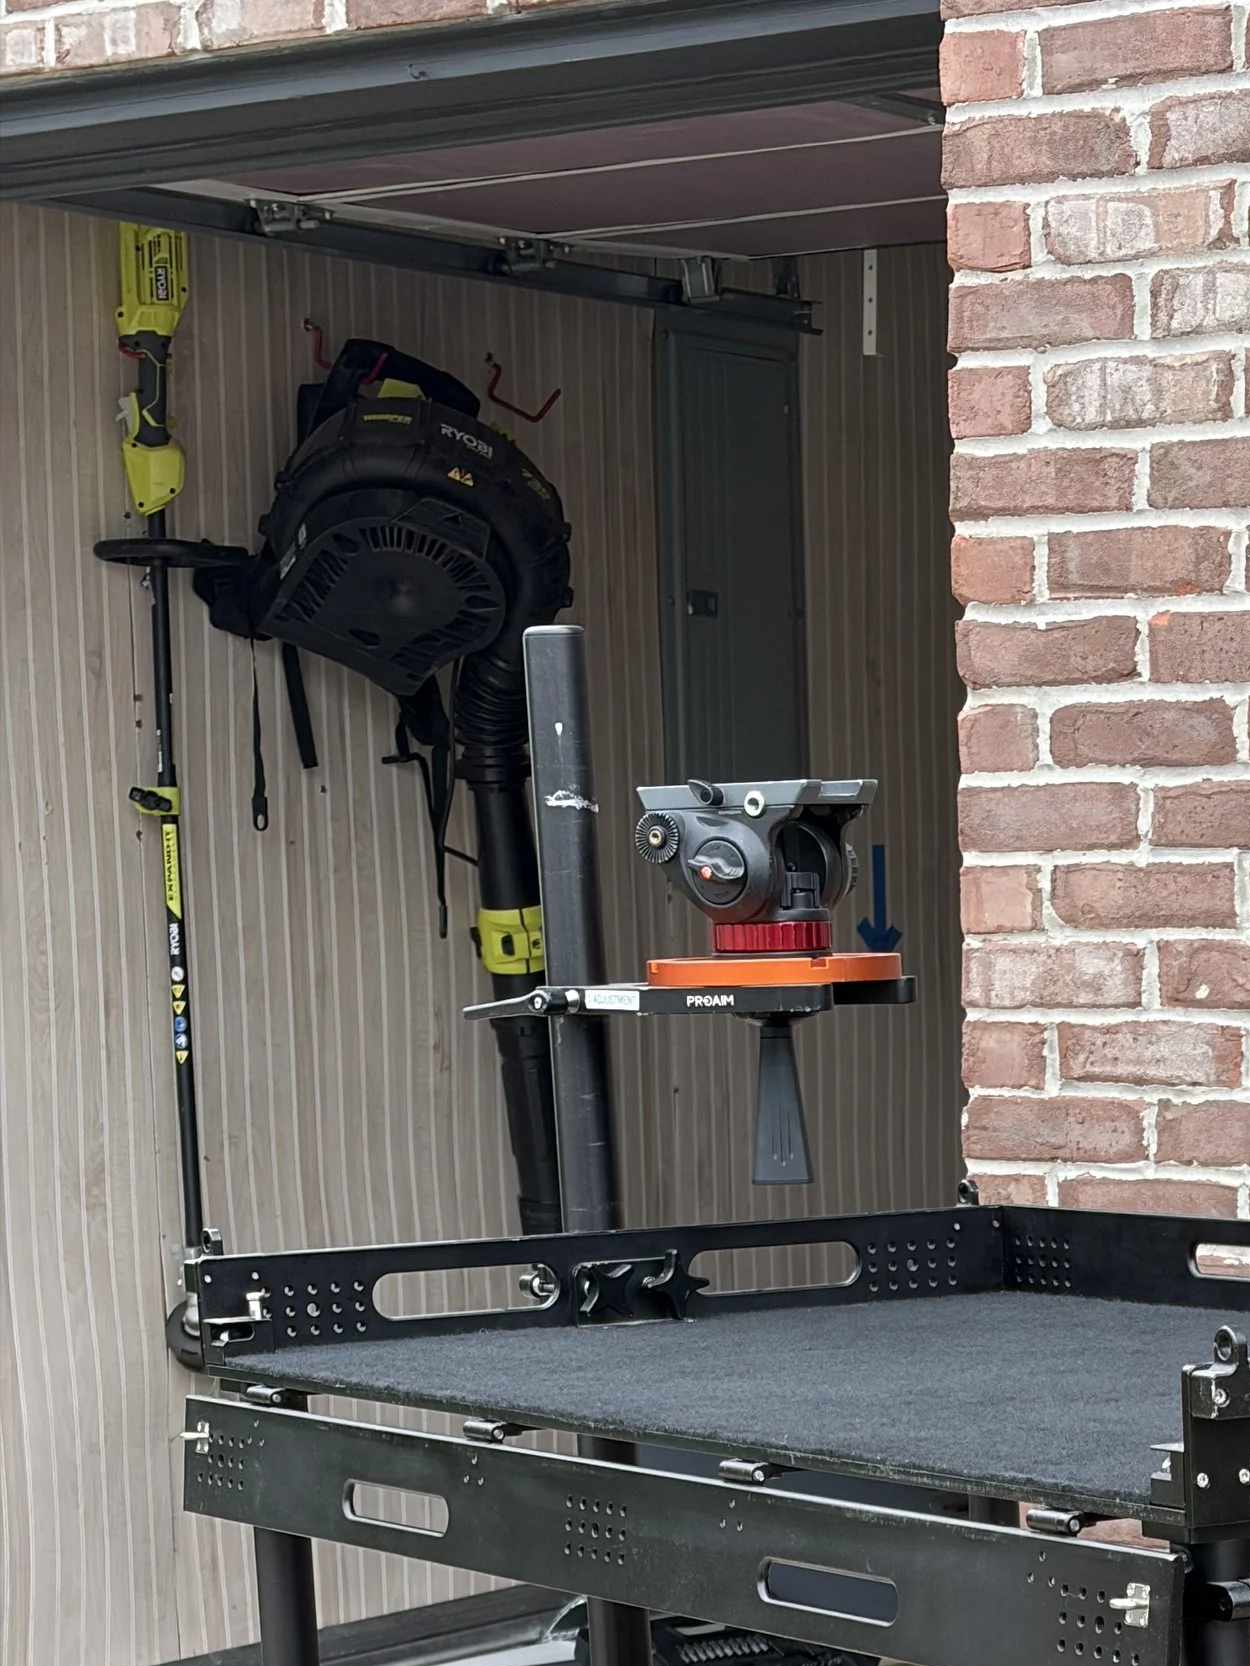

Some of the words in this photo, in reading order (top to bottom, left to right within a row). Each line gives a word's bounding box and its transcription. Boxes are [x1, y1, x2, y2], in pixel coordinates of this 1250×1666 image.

[440, 423, 493, 460] RYOBI
[170, 922, 179, 956] RYOBI
[686, 994, 735, 1008] PROAIM
